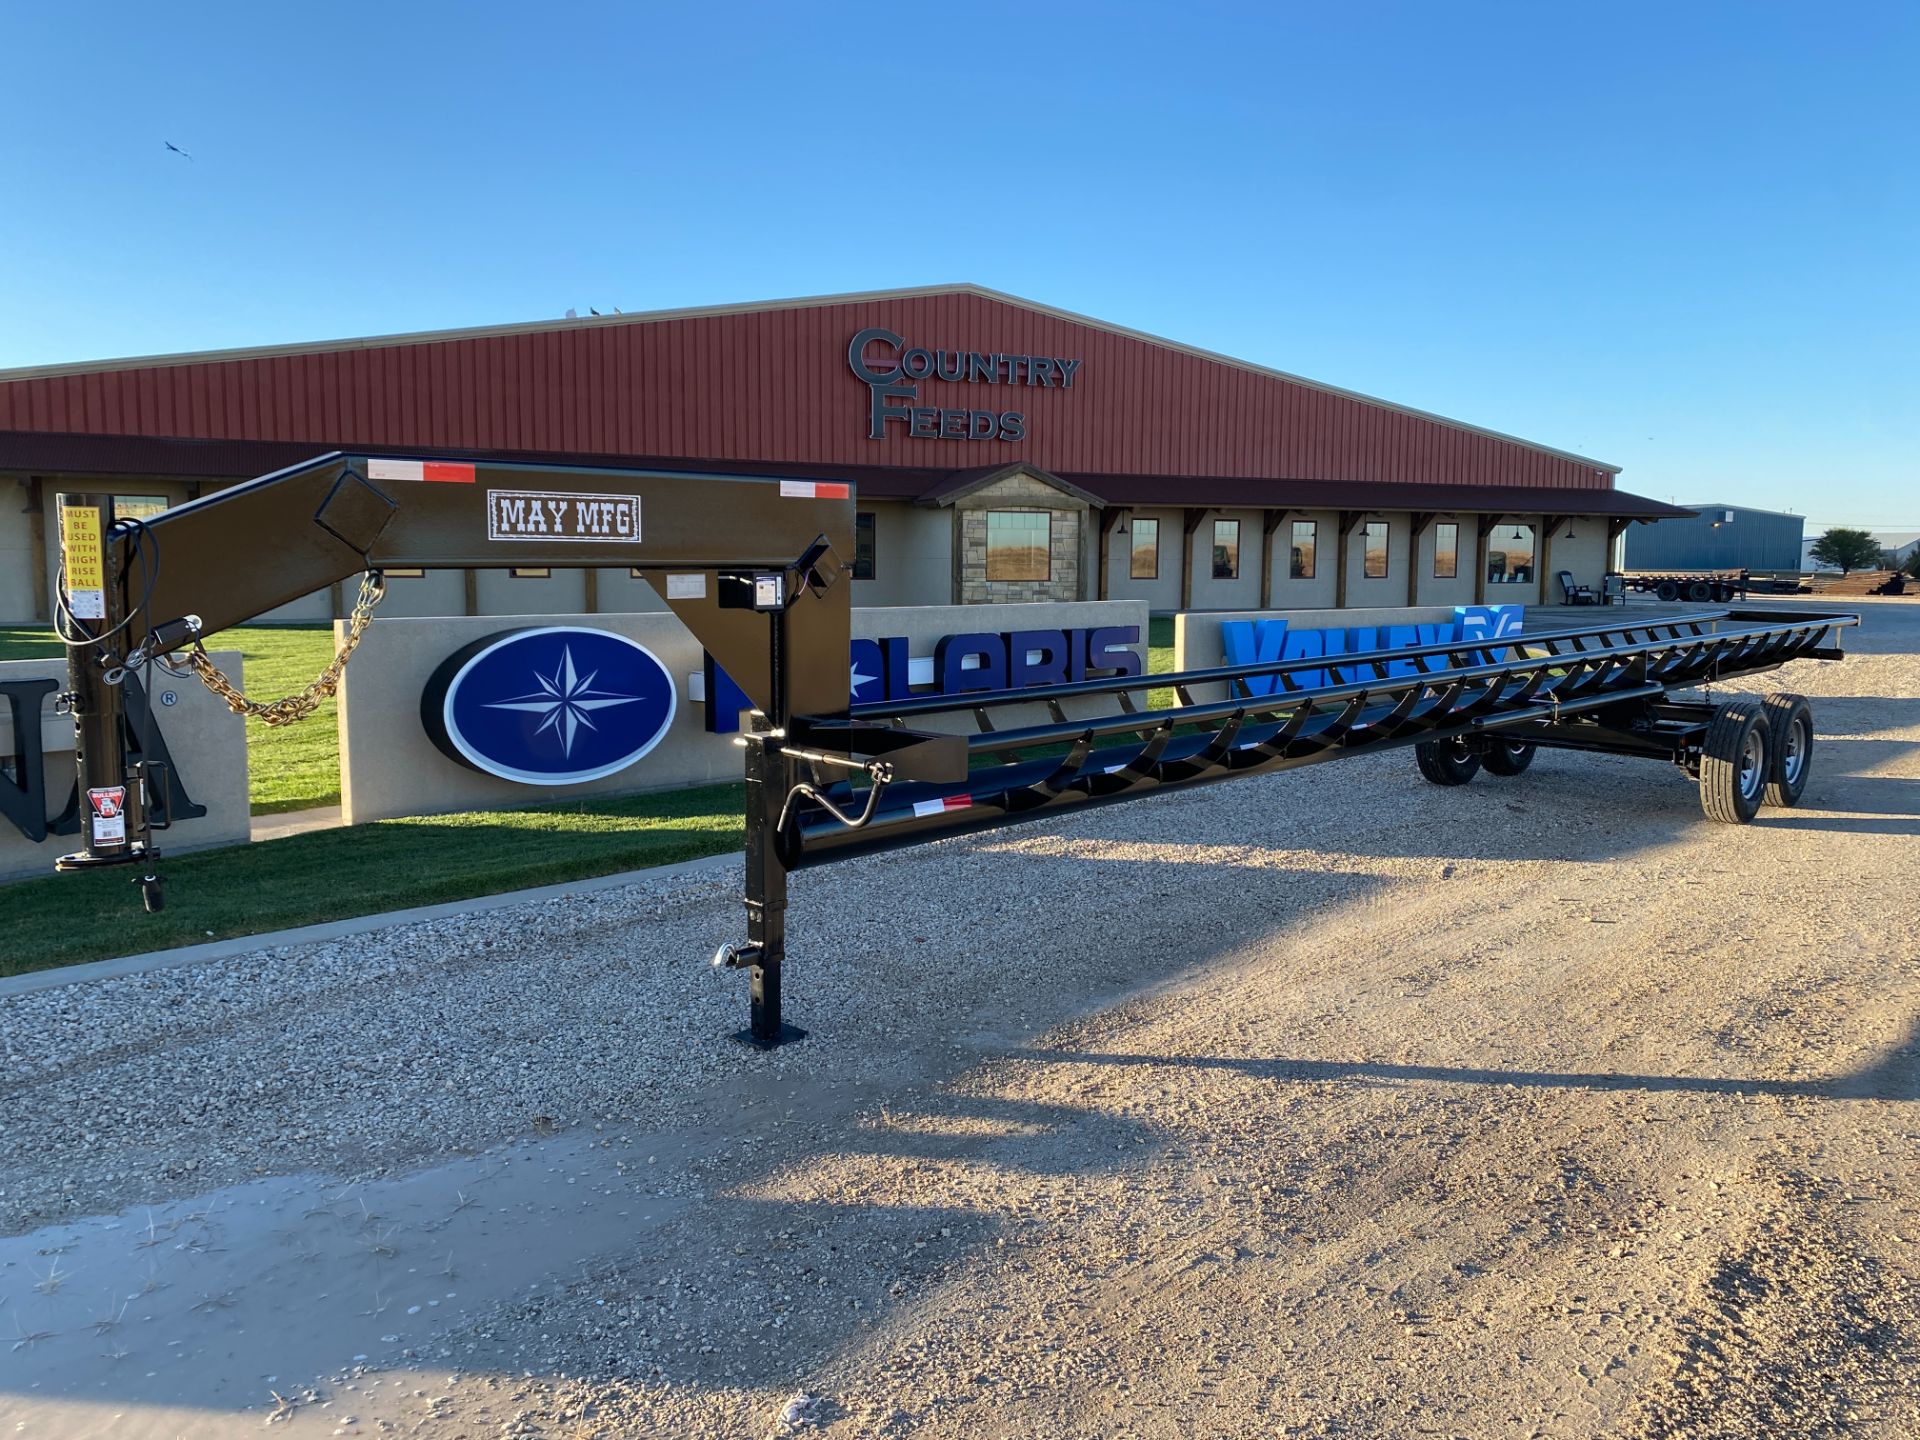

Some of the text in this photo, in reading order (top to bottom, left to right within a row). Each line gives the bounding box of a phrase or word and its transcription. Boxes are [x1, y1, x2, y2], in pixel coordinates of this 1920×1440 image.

[848, 327, 1083, 388] COUNTRY
[869, 383, 1026, 441] FEEDS
[66, 510, 96, 518] MUST
[501, 499, 630, 534] MAY MFG
[73, 521, 88, 530] BE
[67, 533, 97, 541] USED
[68, 544, 97, 553] WITH
[69, 556, 97, 564] HIGH
[71, 567, 96, 575] RISE
[70, 578, 99, 587] BALL
